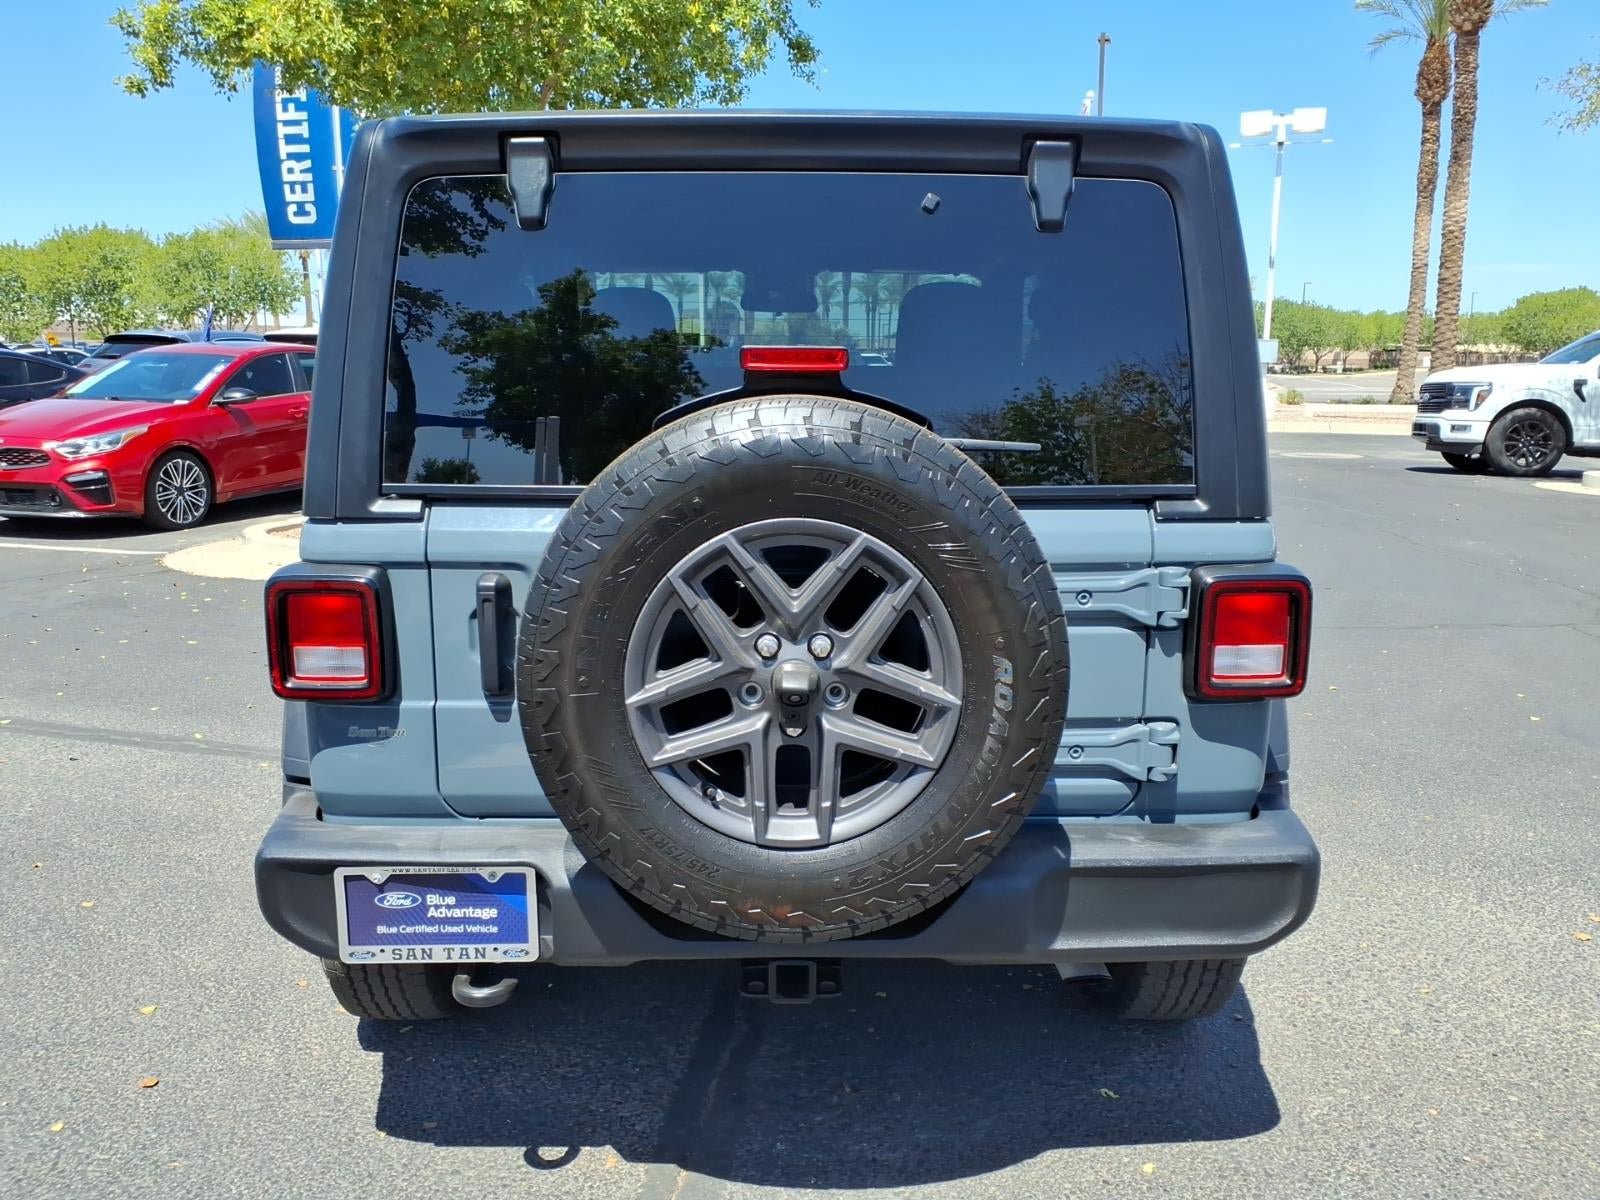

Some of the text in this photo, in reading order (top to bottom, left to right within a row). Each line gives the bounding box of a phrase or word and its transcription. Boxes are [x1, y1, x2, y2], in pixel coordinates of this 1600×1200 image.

[275, 66, 318, 224] CERTIFI
[809, 471, 919, 514] All-Weather
[382, 893, 414, 906] Ford
[427, 894, 456, 905] Blue
[427, 906, 498, 919] Advantage
[377, 924, 498, 934] Blue Certified Used Vehicle
[351, 951, 375, 959] Ford
[391, 947, 487, 960] SAN TAN
[504, 949, 528, 957] Ford
